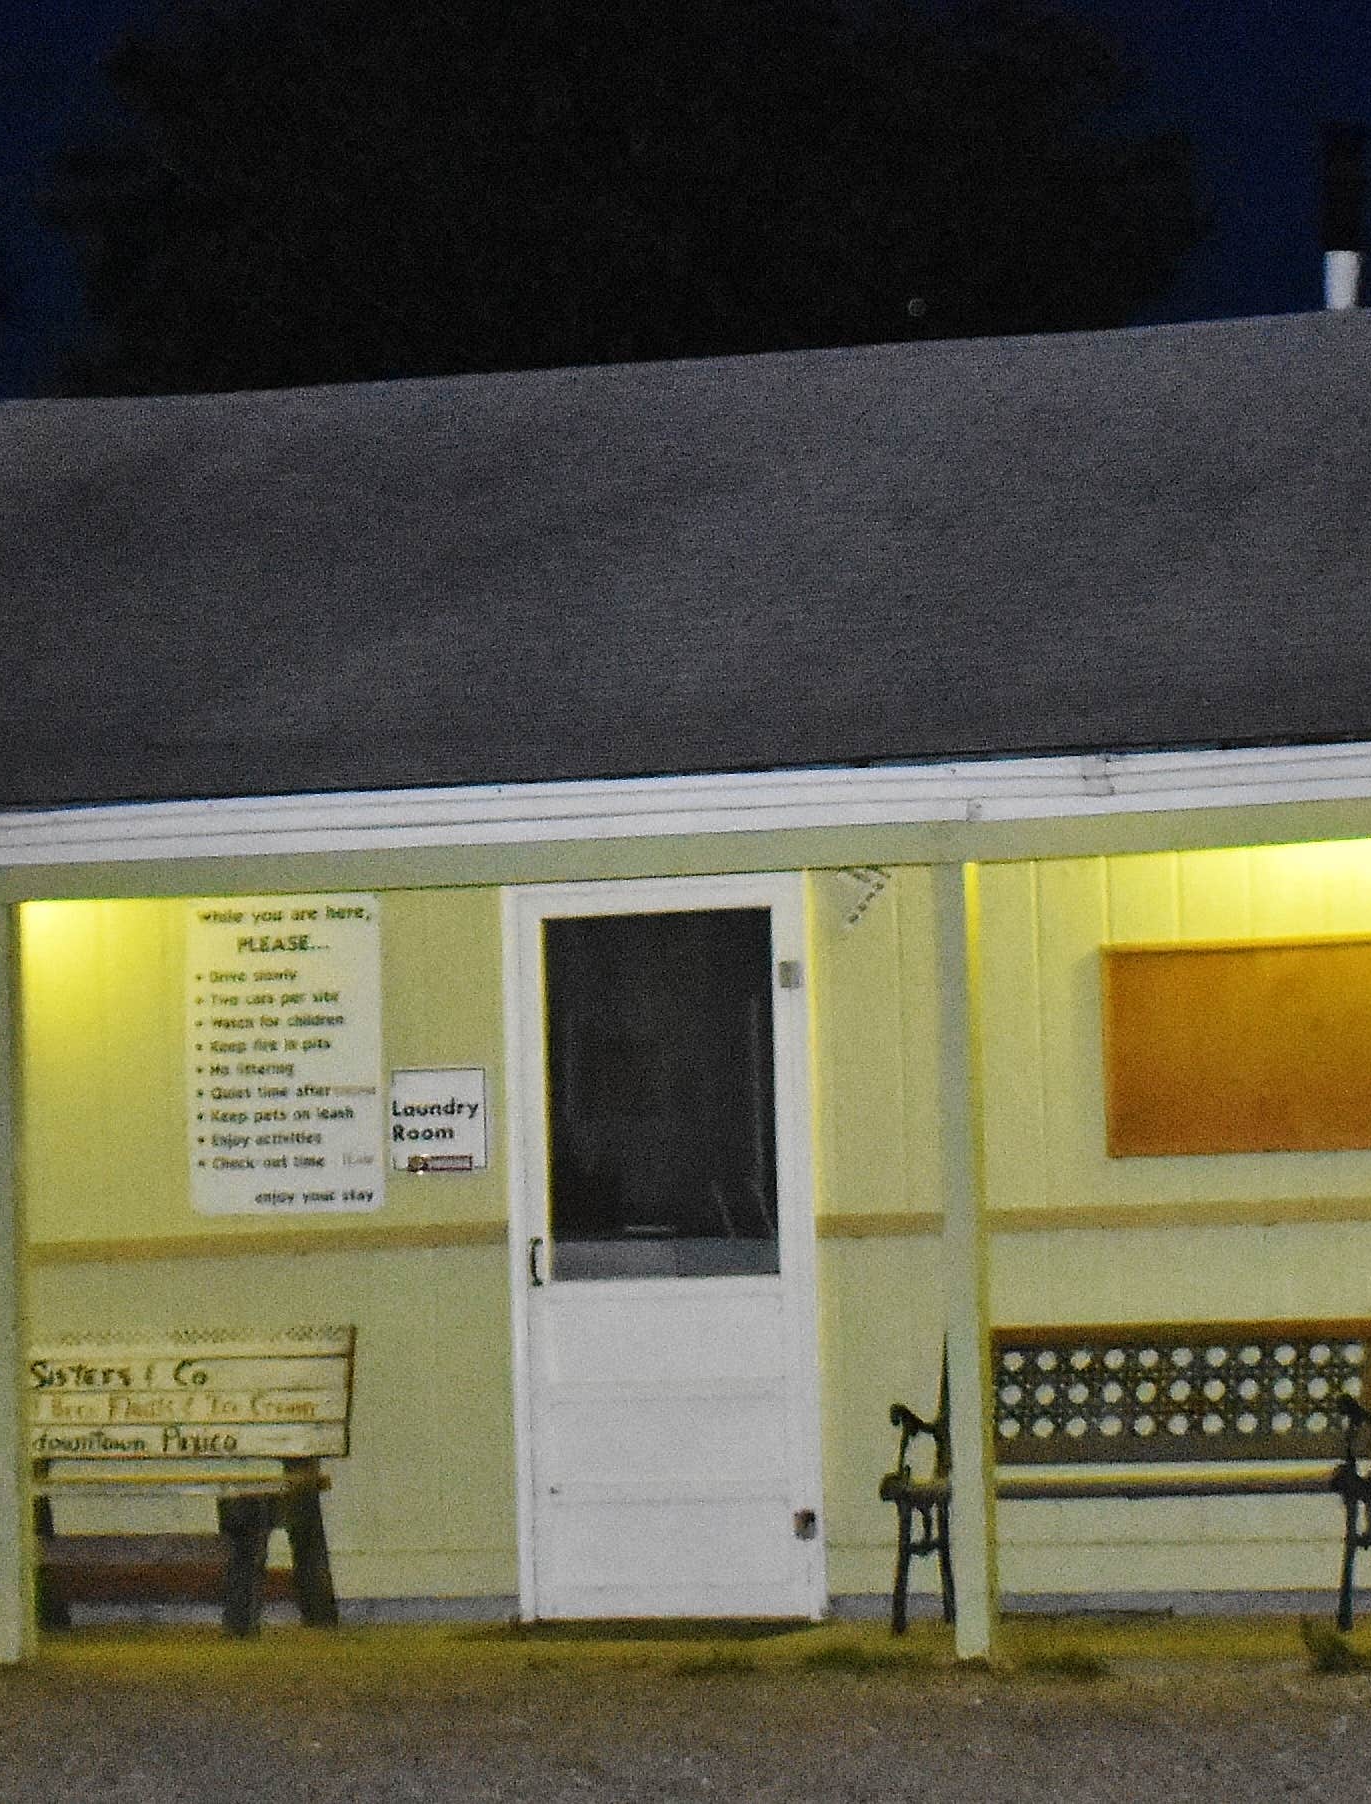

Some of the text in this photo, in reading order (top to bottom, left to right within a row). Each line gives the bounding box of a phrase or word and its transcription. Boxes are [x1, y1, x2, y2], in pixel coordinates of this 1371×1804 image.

[252, 910, 283, 925] you
[291, 908, 318, 921] are
[212, 993, 239, 1006] Two
[280, 992, 306, 1007] per
[312, 990, 340, 1003] site
[211, 1013, 345, 1029] Watch for children
[209, 1039, 247, 1053] Keep
[209, 1061, 295, 1077] No littering
[211, 1085, 252, 1100] Quiet
[257, 1086, 288, 1098] time
[295, 1084, 331, 1098] after
[210, 1106, 355, 1124] Keep pets on leash
[391, 1096, 479, 1121] Laundry
[211, 1131, 322, 1149] Enjoy activities
[391, 1123, 455, 1142] Room
[293, 1155, 326, 1169] time
[254, 1188, 374, 1206] enjoy your stay
